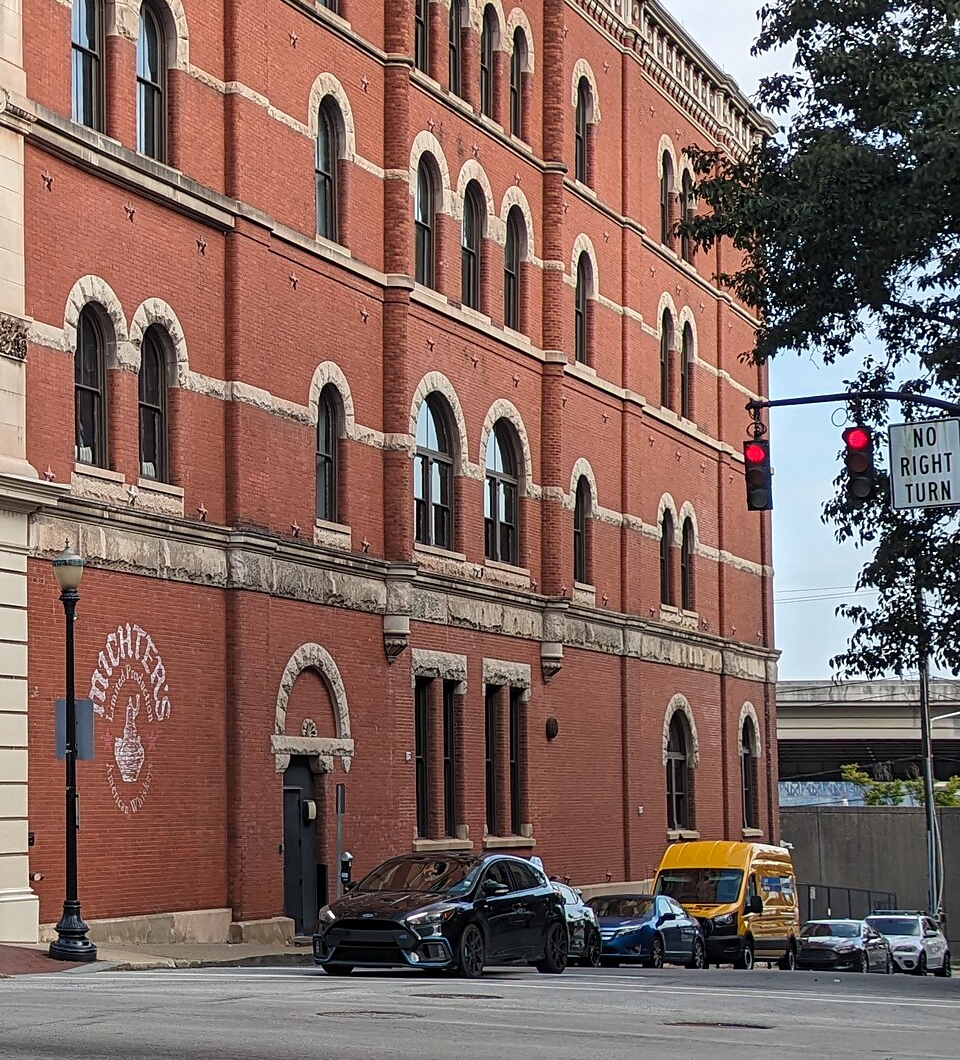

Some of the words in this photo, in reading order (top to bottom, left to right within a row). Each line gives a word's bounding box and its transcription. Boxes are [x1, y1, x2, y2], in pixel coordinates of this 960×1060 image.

[913, 426, 937, 448] NO
[900, 452, 952, 477] RIGHT
[905, 480, 952, 503] TURN
[105, 668, 126, 723] Limited
[126, 664, 154, 723] Production
[105, 763, 129, 815] American
